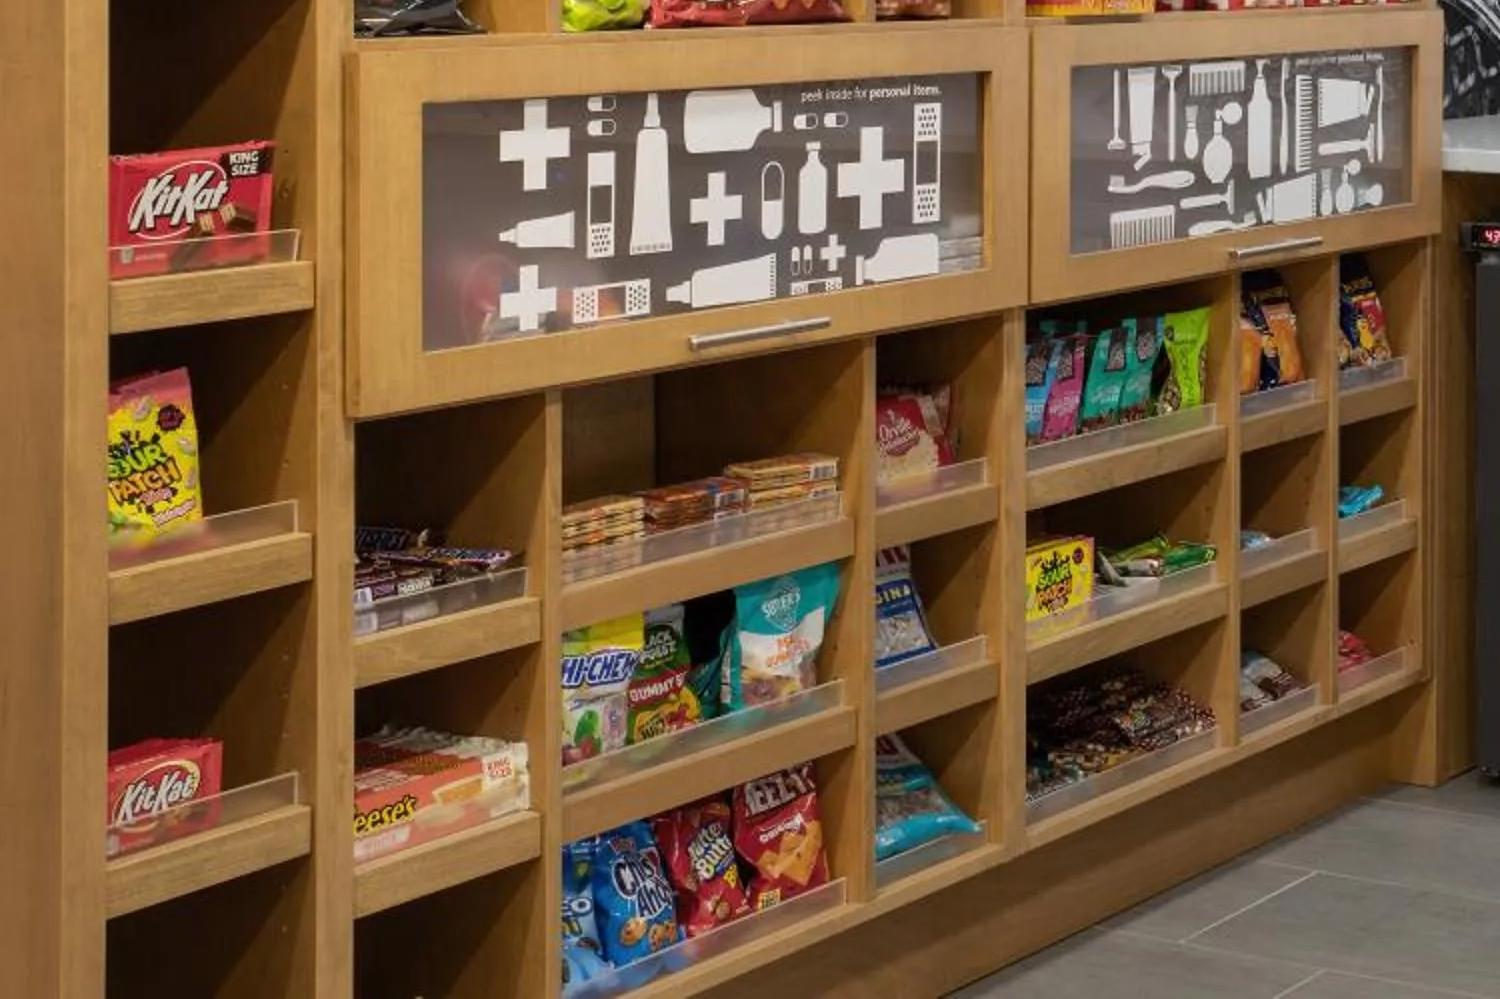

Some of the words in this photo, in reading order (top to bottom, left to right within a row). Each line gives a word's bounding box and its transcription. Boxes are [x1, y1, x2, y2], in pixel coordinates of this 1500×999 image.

[868, 84, 912, 100] personal
[229, 151, 260, 165] KING
[231, 163, 259, 177] SIZE
[353, 795, 417, 837] eese's
